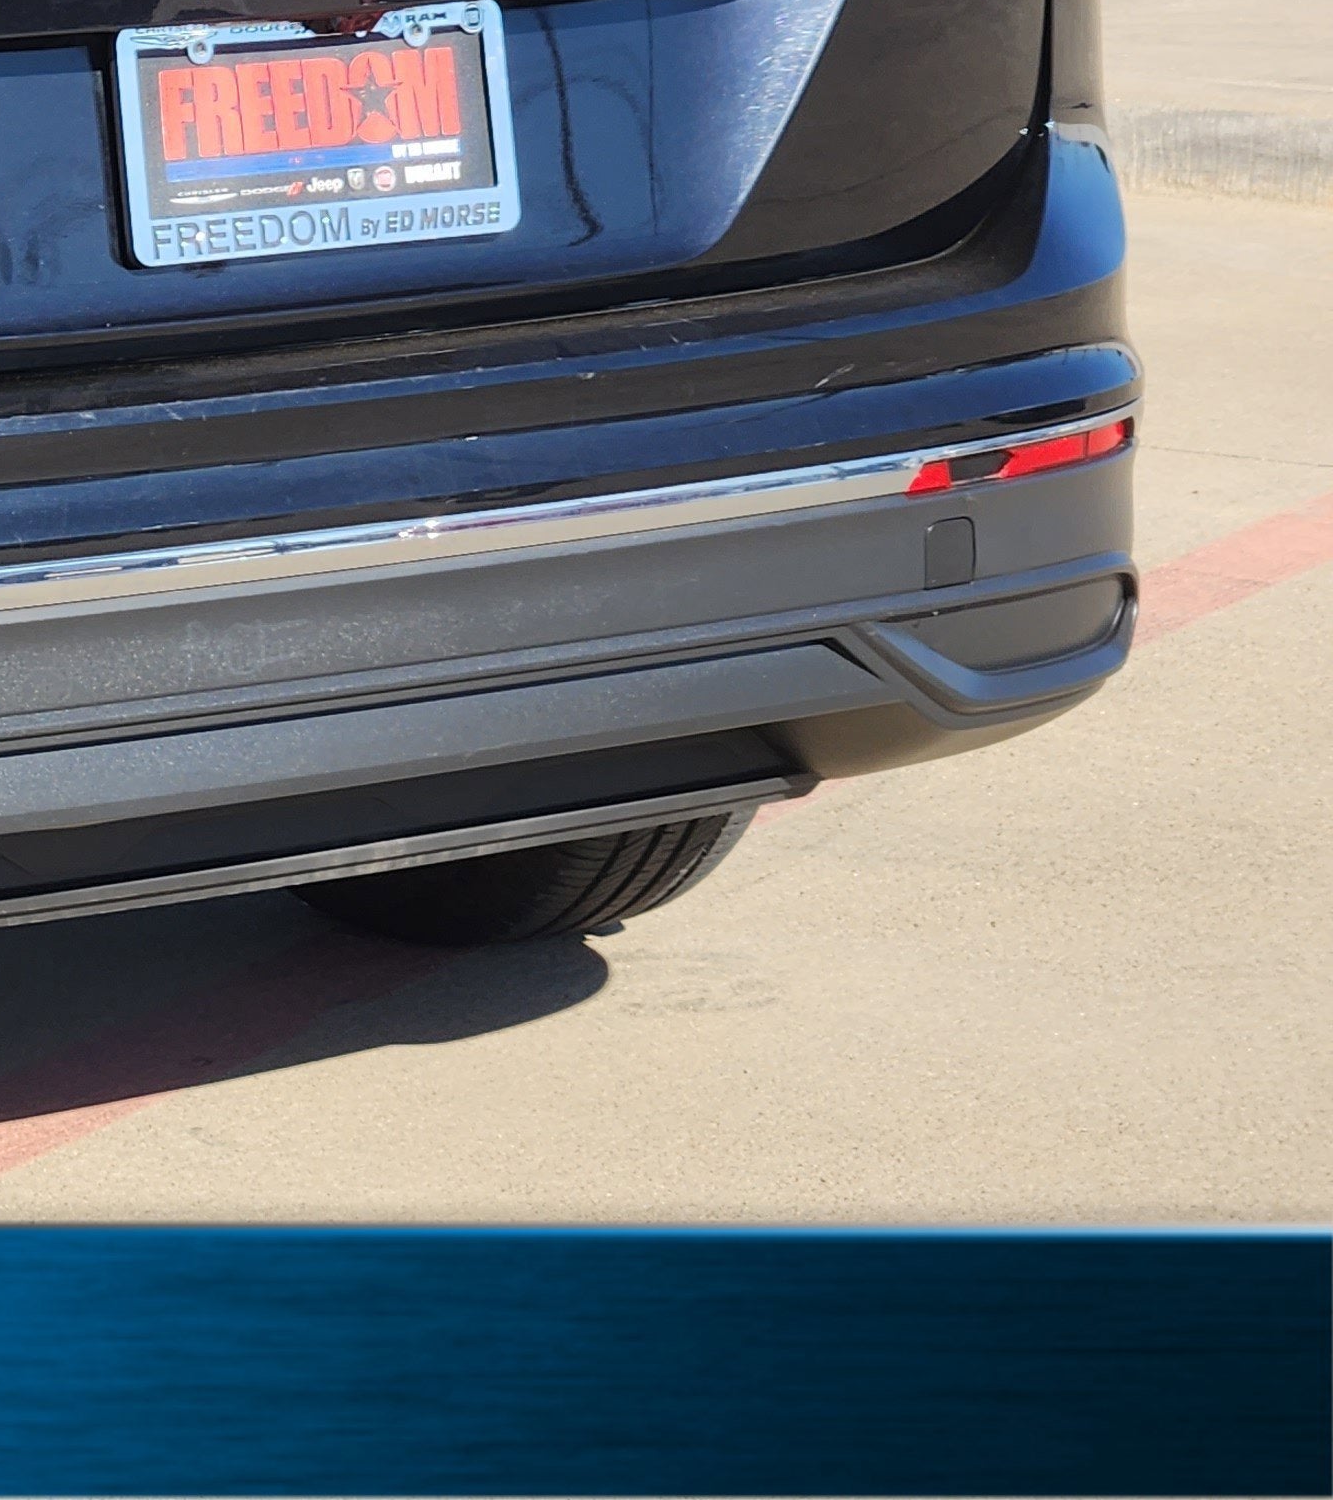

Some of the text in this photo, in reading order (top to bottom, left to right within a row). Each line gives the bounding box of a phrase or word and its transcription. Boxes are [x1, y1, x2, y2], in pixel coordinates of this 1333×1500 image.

[405, 11, 448, 23] RAM
[158, 46, 461, 161] FREEDOM
[306, 177, 345, 194] Jeep
[151, 206, 352, 260] FREEDOM
[385, 210, 414, 234] ED
[420, 201, 501, 231] MORSE
